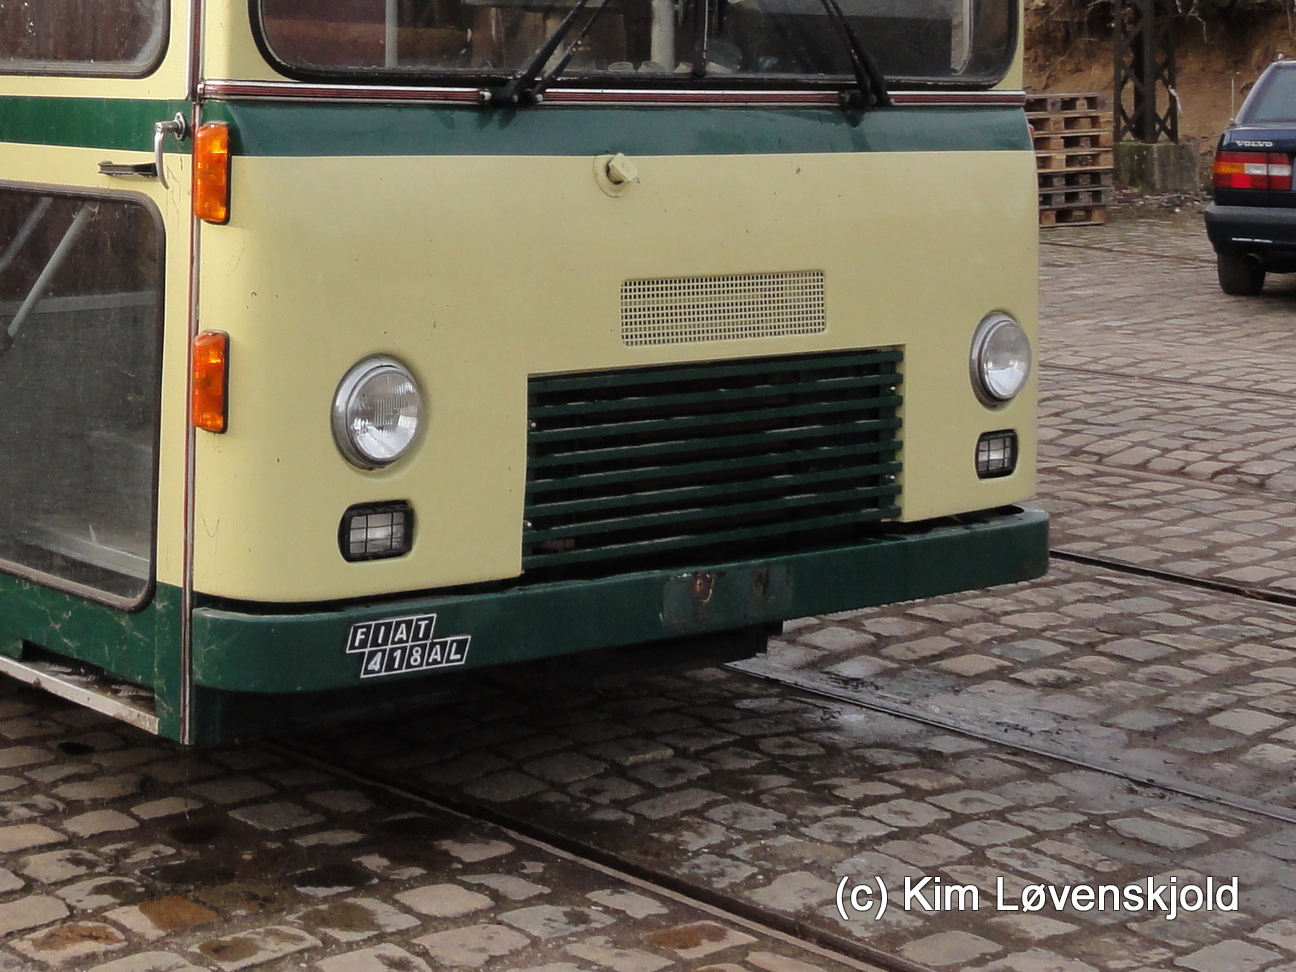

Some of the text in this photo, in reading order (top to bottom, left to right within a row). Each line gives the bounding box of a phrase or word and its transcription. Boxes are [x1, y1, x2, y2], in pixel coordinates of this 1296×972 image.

[1235, 140, 1274, 148] VOLVO
[354, 620, 430, 647] FIAT
[367, 642, 462, 672] 418AL
